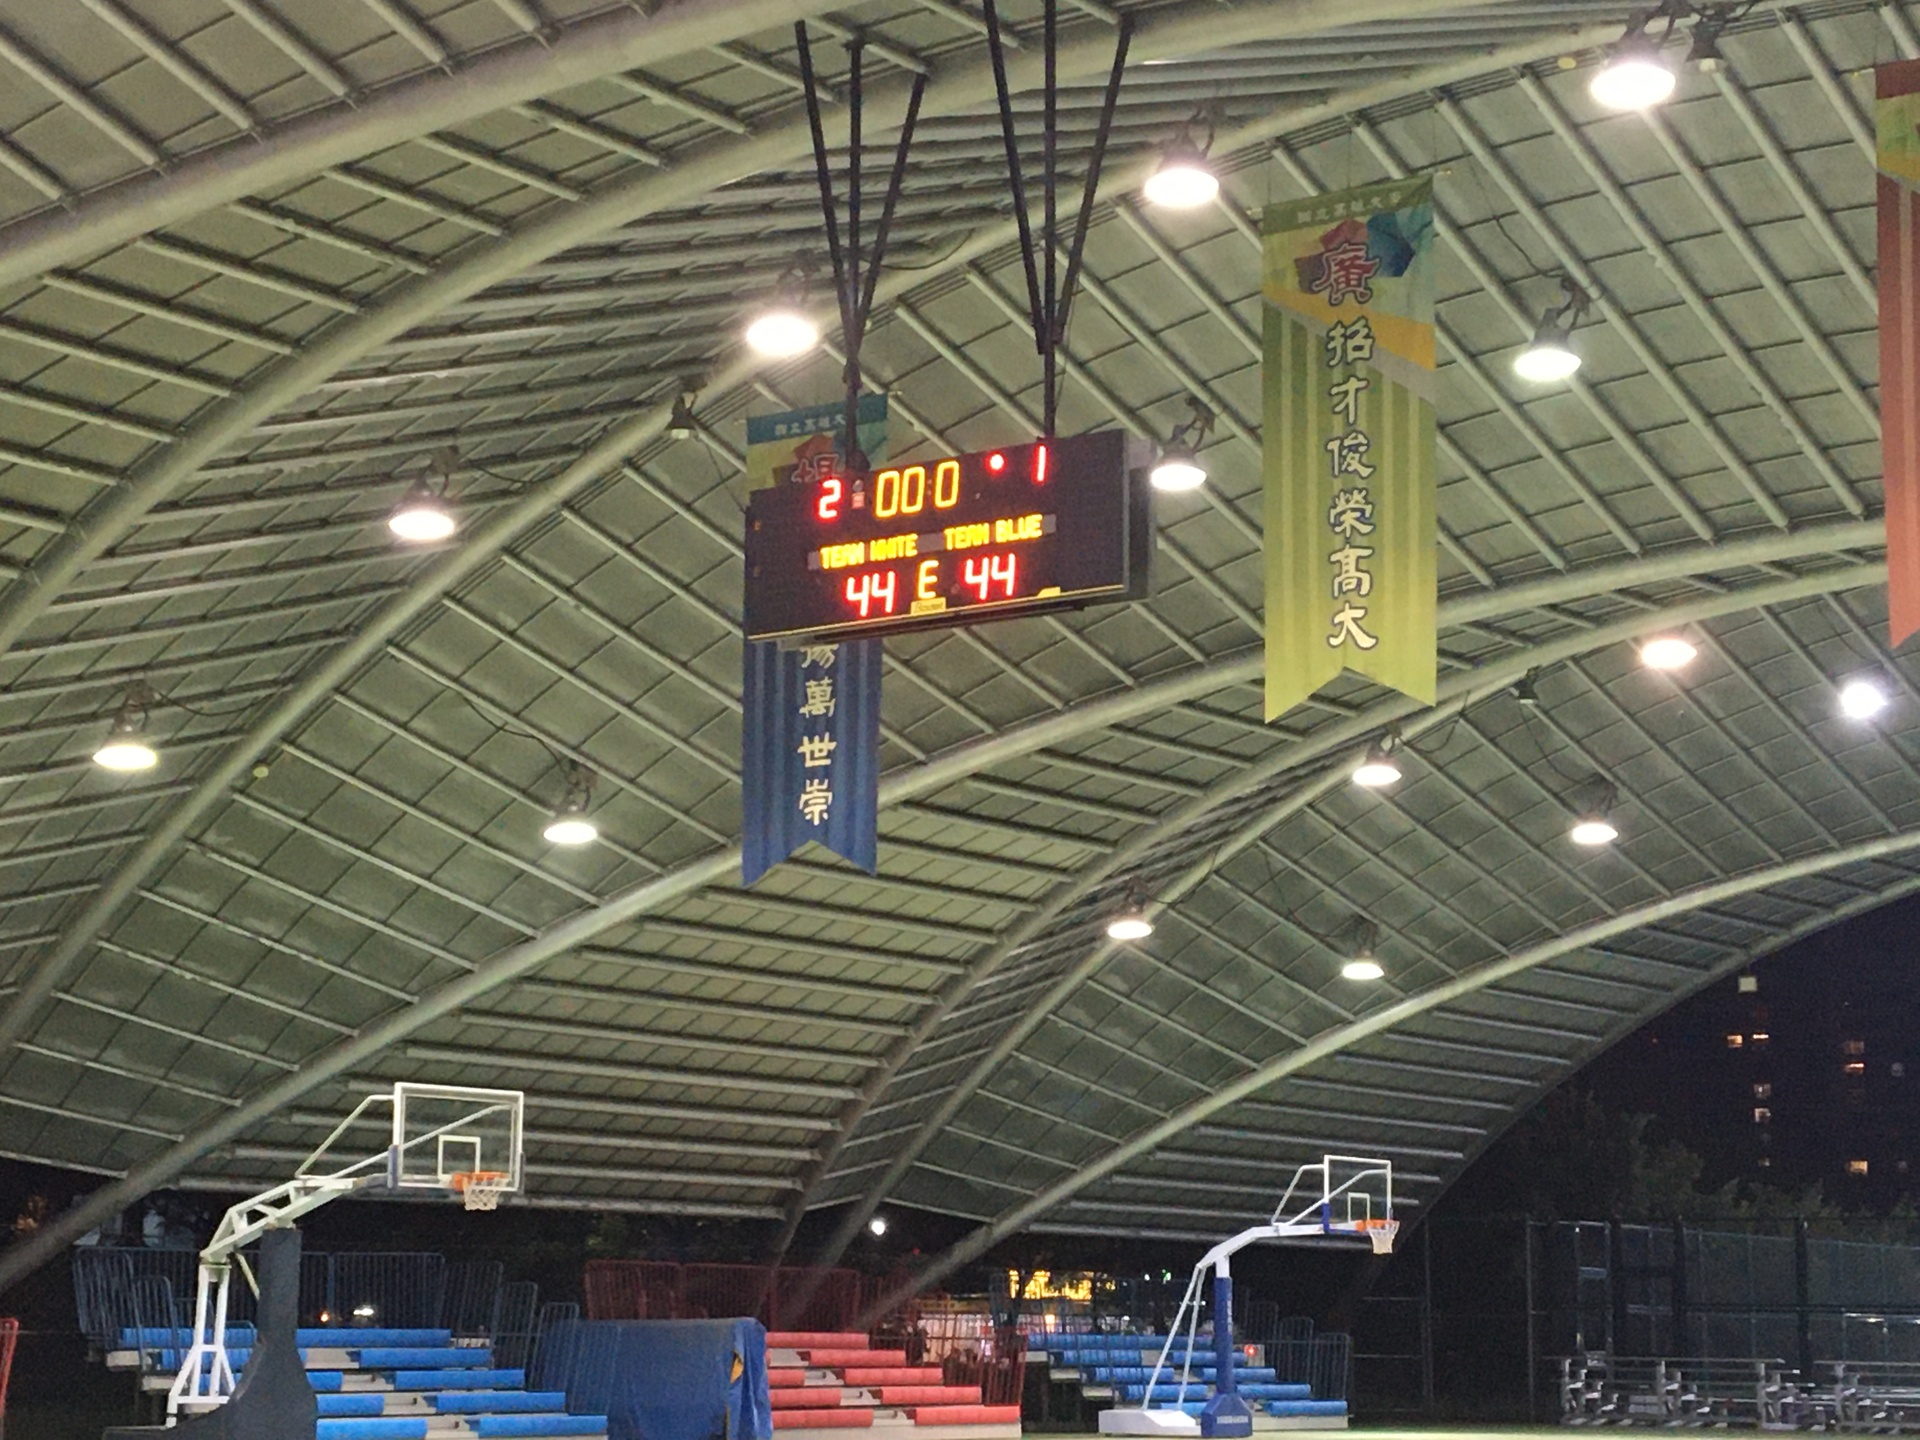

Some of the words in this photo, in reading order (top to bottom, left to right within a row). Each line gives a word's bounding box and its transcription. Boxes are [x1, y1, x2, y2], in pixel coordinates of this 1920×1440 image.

[818, 478, 842, 519] 2
[1036, 445, 1048, 483] 1
[944, 522, 989, 550] TEAM
[995, 513, 1043, 543] BLUE
[820, 541, 865, 569] TEAM
[964, 553, 1016, 600] 44
[845, 570, 896, 617] 44
[917, 559, 939, 599] E
